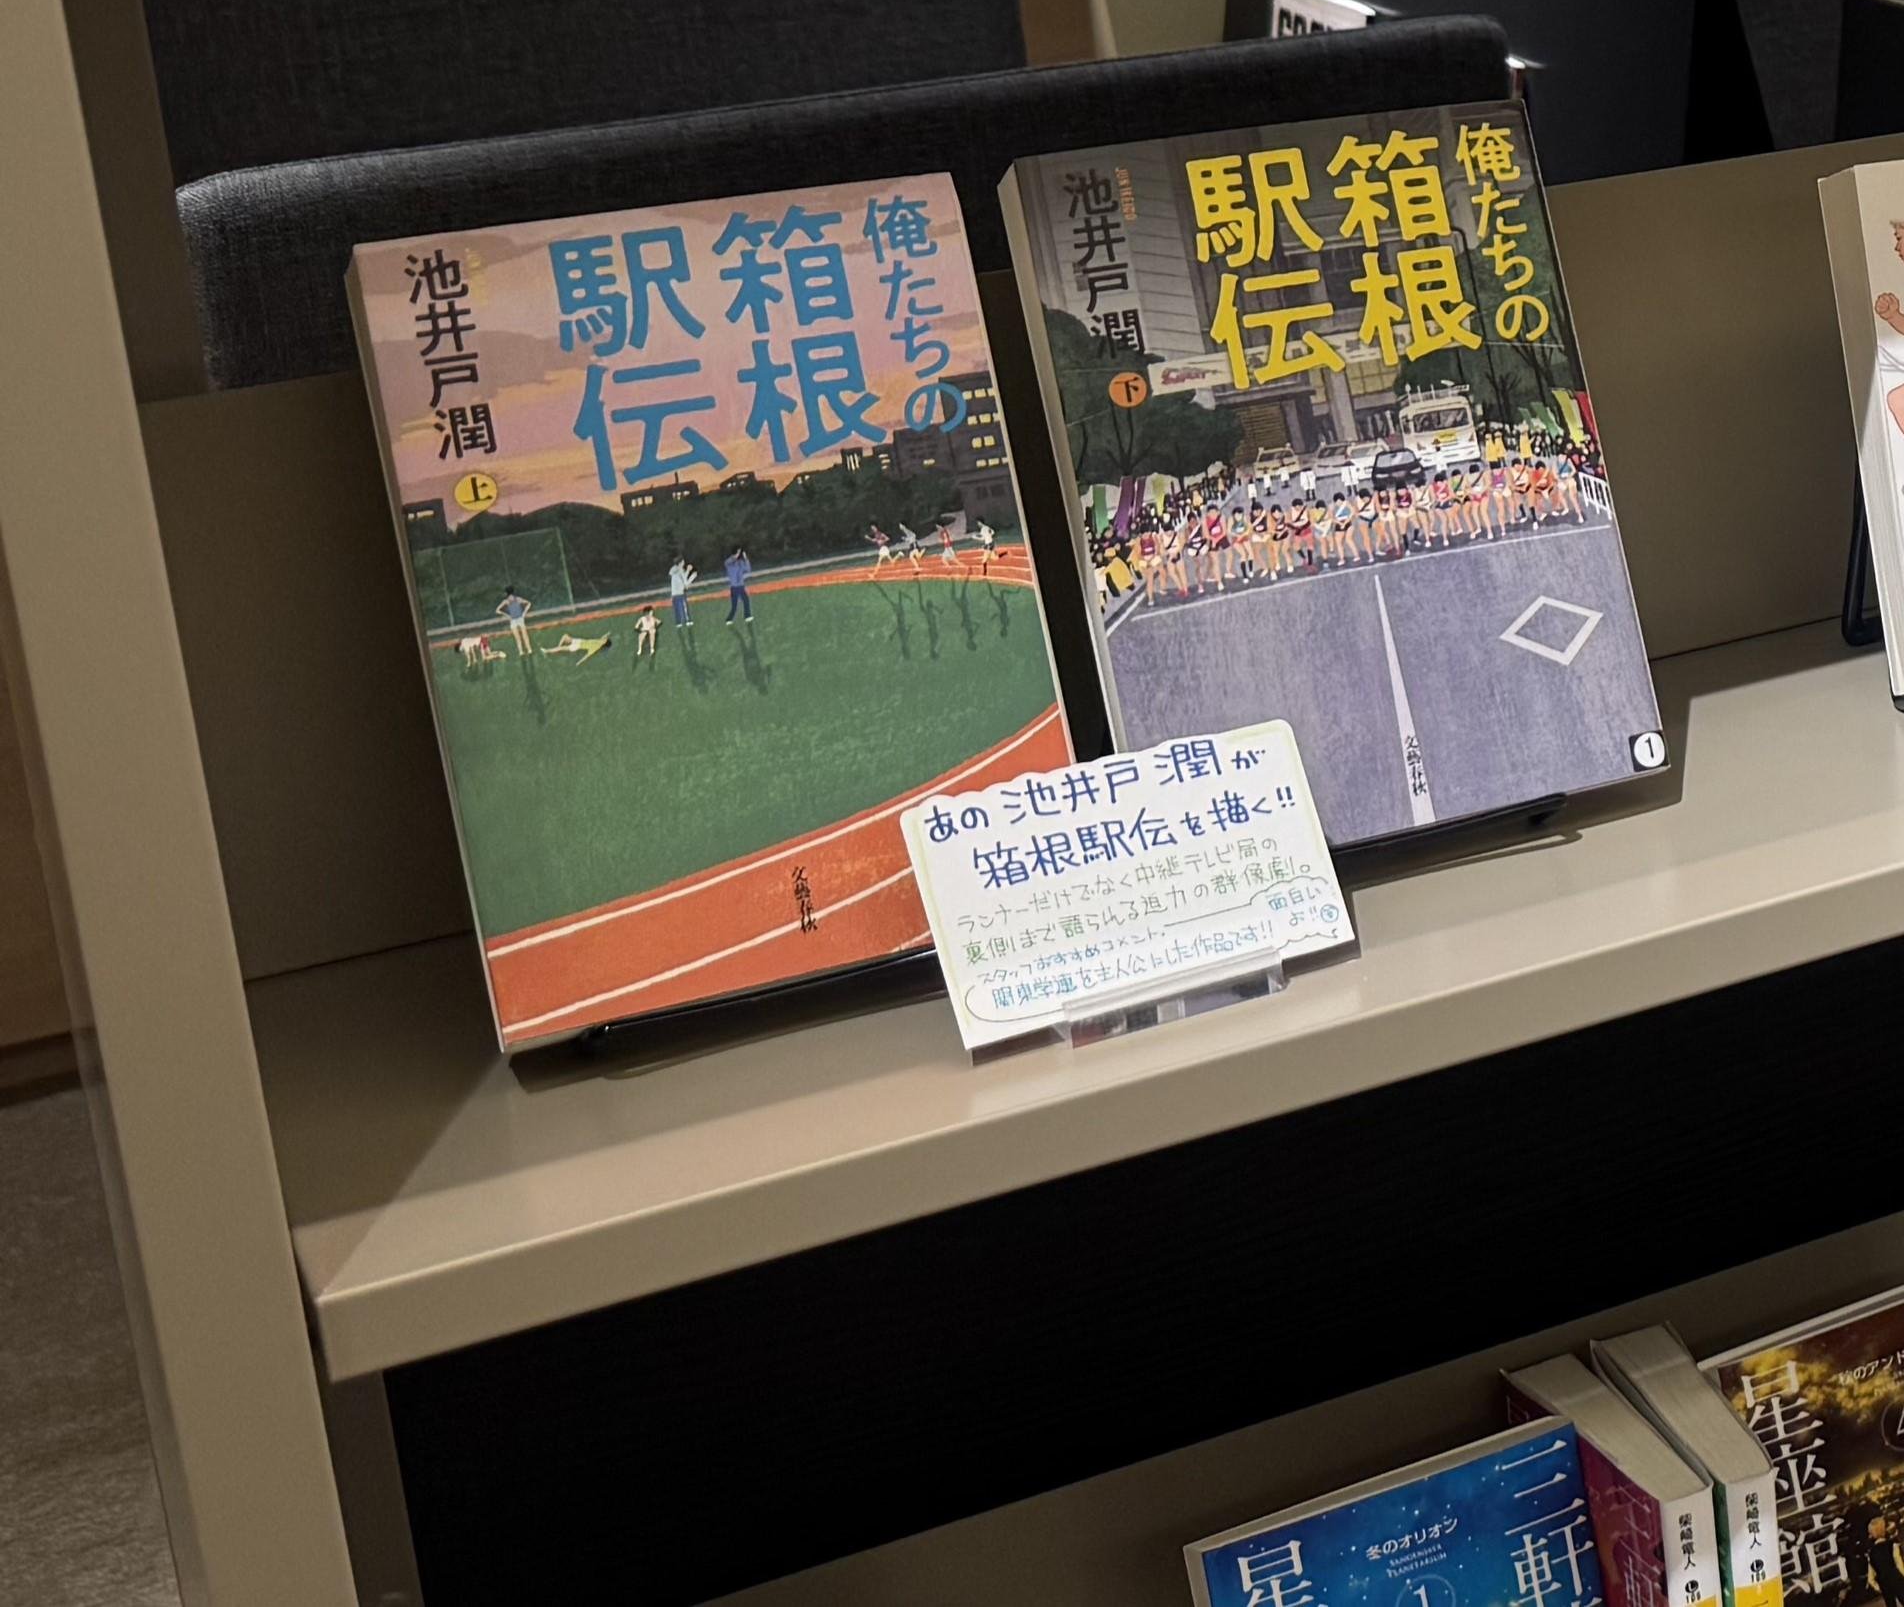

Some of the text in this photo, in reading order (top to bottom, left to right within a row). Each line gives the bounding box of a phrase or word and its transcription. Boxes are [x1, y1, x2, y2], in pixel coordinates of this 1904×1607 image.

[711, 204, 889, 466] 箱根
[863, 195, 967, 436] 俺たちの
[1062, 167, 1147, 359] 池井戸潤
[1185, 147, 1347, 391] 駅伝
[1326, 131, 1484, 369] 箱根
[1455, 122, 1550, 344] 俺たちの
[402, 248, 498, 459] 池井戸潤
[547, 226, 731, 493] 駅伝
[1113, 377, 1145, 403] 下
[462, 477, 493, 505] 上
[1365, 1516, 1459, 1561] 冬のオリオン
[1500, 1438, 1604, 1607] 三軒
